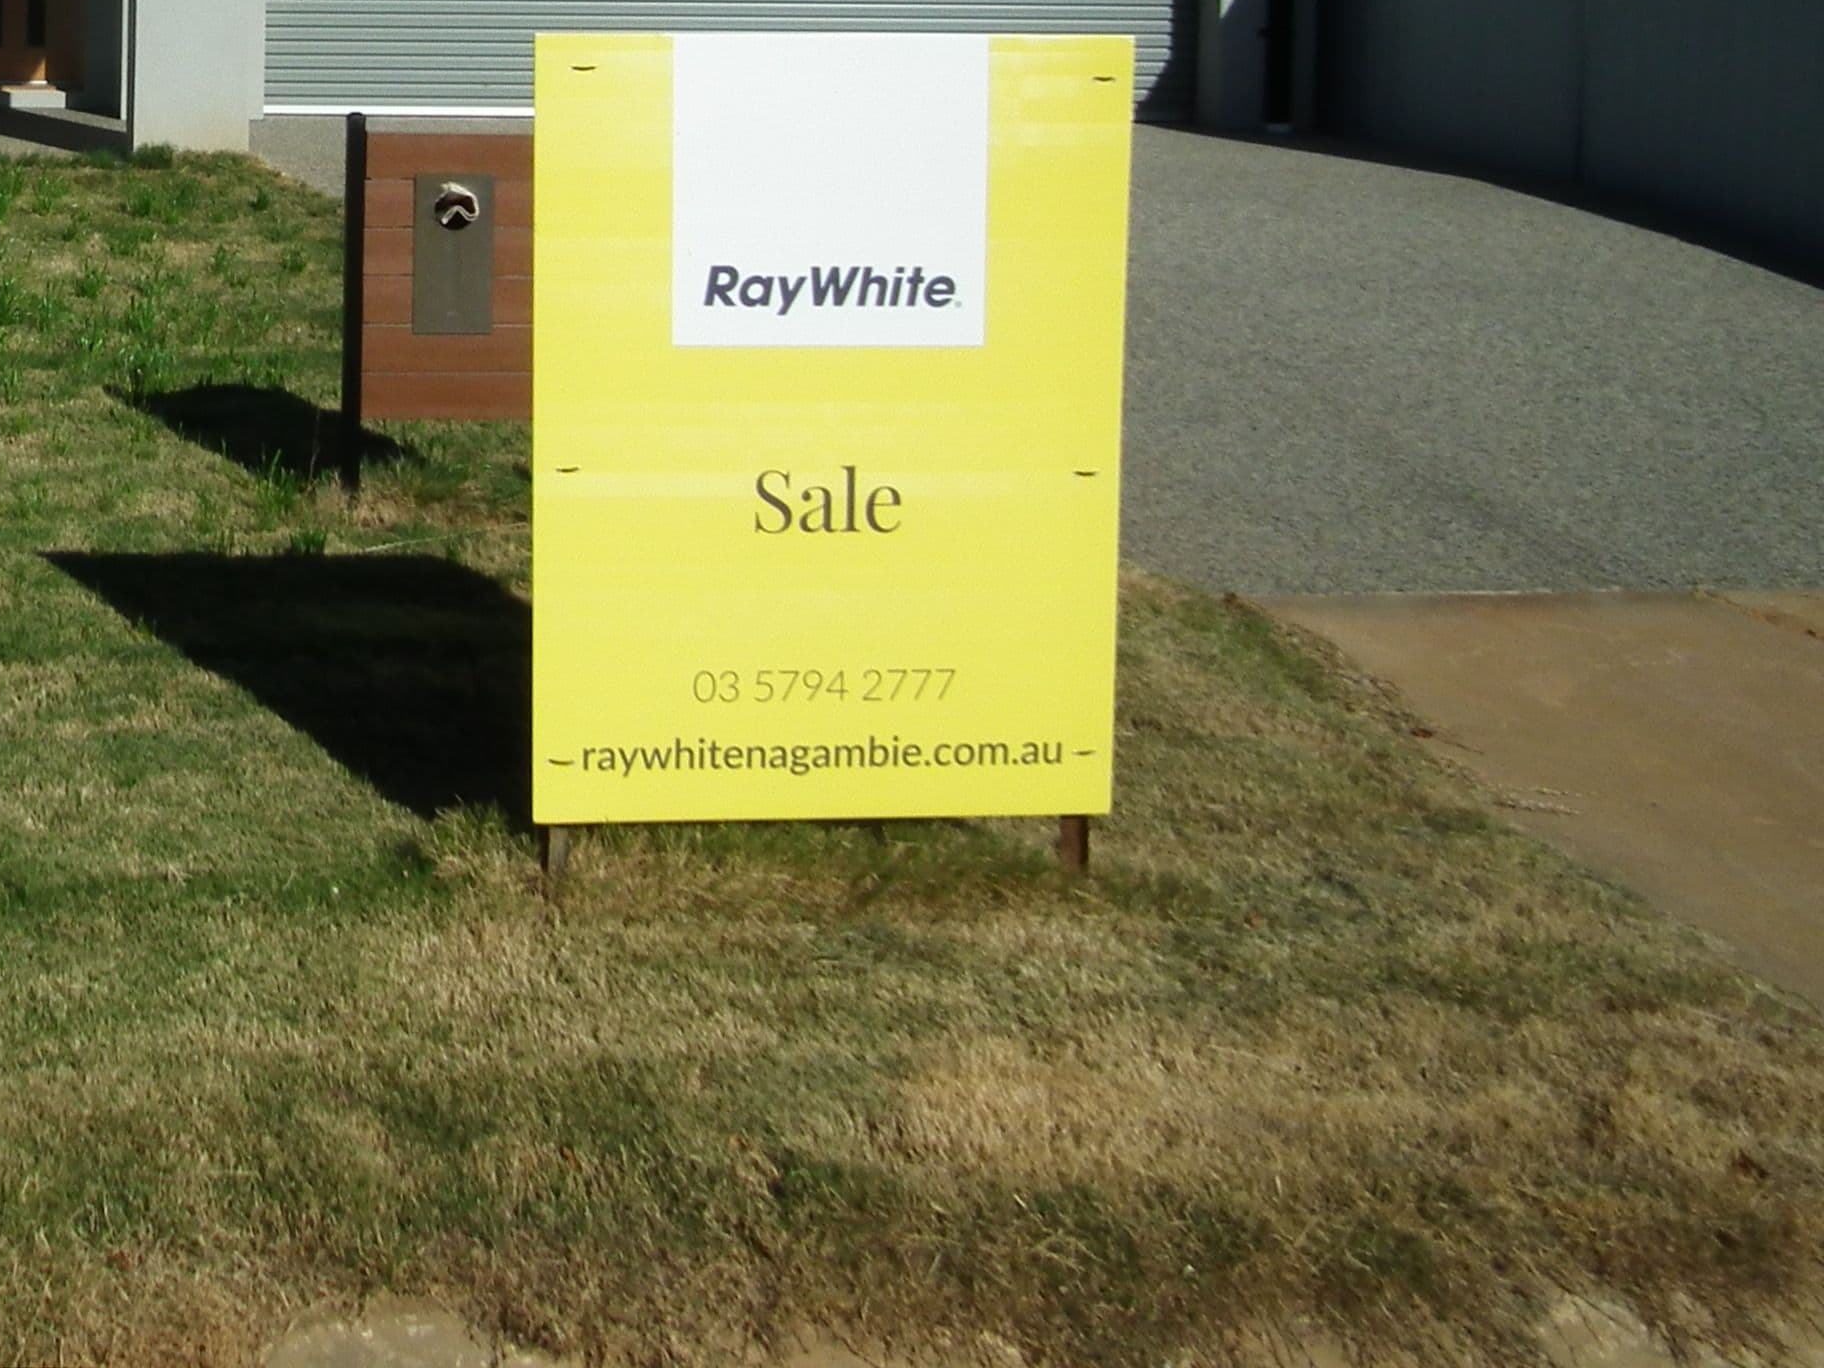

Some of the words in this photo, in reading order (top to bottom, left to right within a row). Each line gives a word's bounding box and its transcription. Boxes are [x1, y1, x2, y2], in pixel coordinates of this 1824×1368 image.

[755, 465, 902, 534] Sale
[692, 670, 740, 704] 03
[754, 669, 849, 703] 5794
[862, 668, 956, 702] 2777
[582, 734, 1063, 777] raywhitenagambie.com.au
